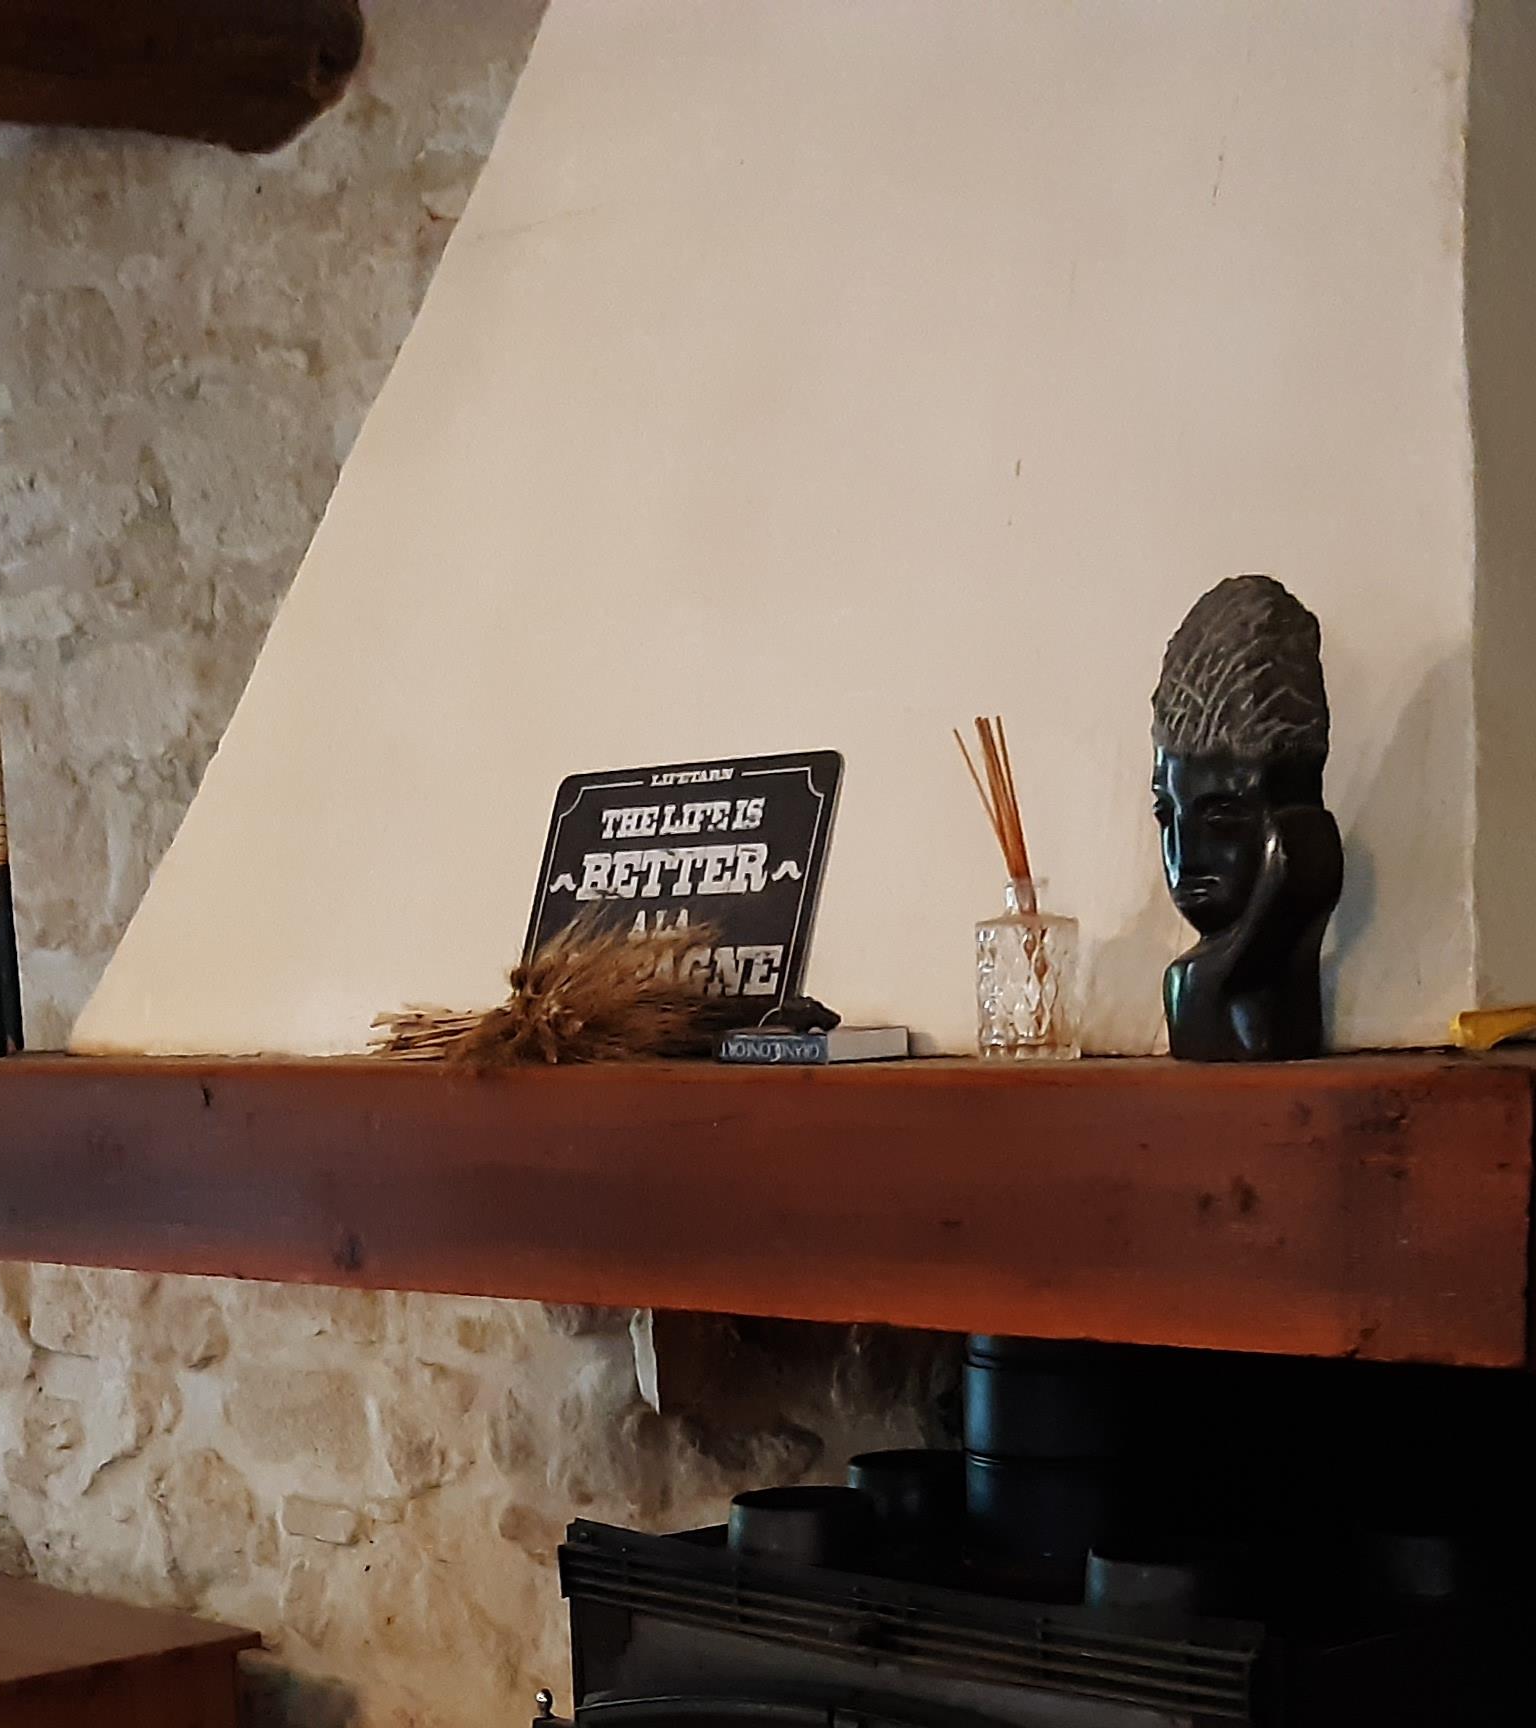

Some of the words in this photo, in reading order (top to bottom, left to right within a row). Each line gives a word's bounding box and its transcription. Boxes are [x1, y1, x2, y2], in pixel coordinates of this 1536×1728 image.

[601, 805, 661, 840] THE
[658, 800, 732, 836] LIFE
[731, 797, 766, 831] IS
[576, 843, 768, 900] BETTER
